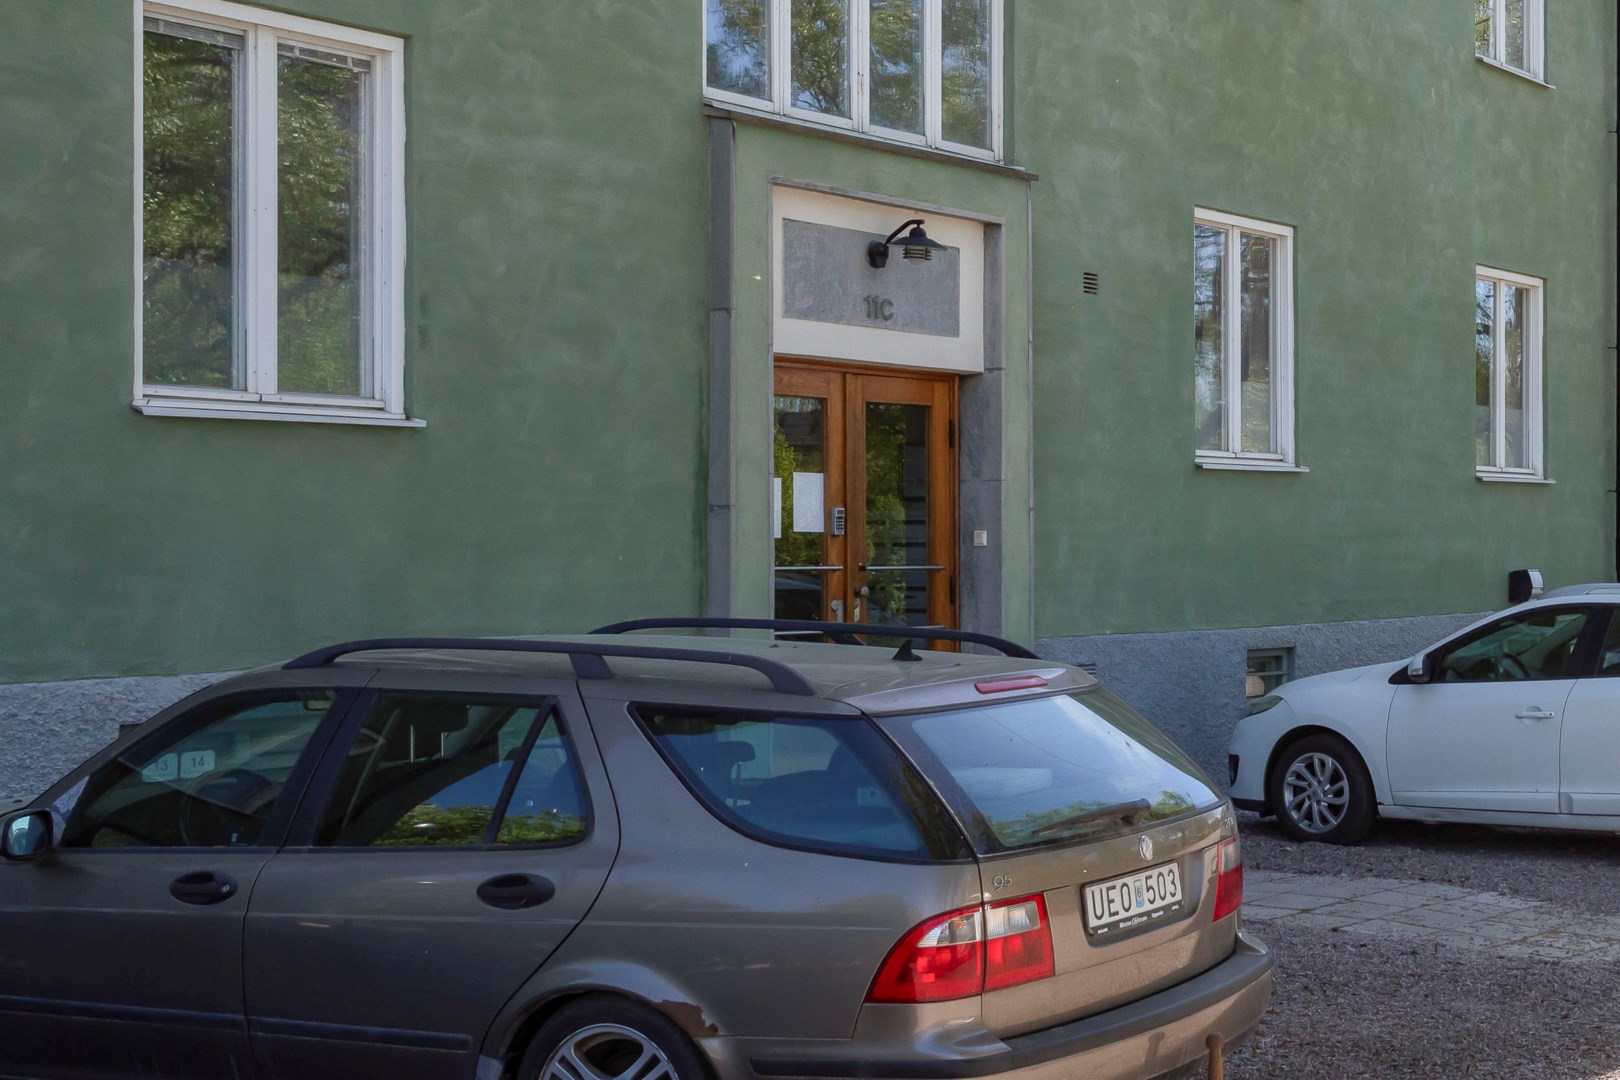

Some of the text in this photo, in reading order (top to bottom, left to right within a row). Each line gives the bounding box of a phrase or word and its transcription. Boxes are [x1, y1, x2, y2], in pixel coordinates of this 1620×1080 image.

[863, 294, 895, 321] 11C
[191, 756, 205, 768] 14
[1091, 868, 1178, 921] UEO 503
